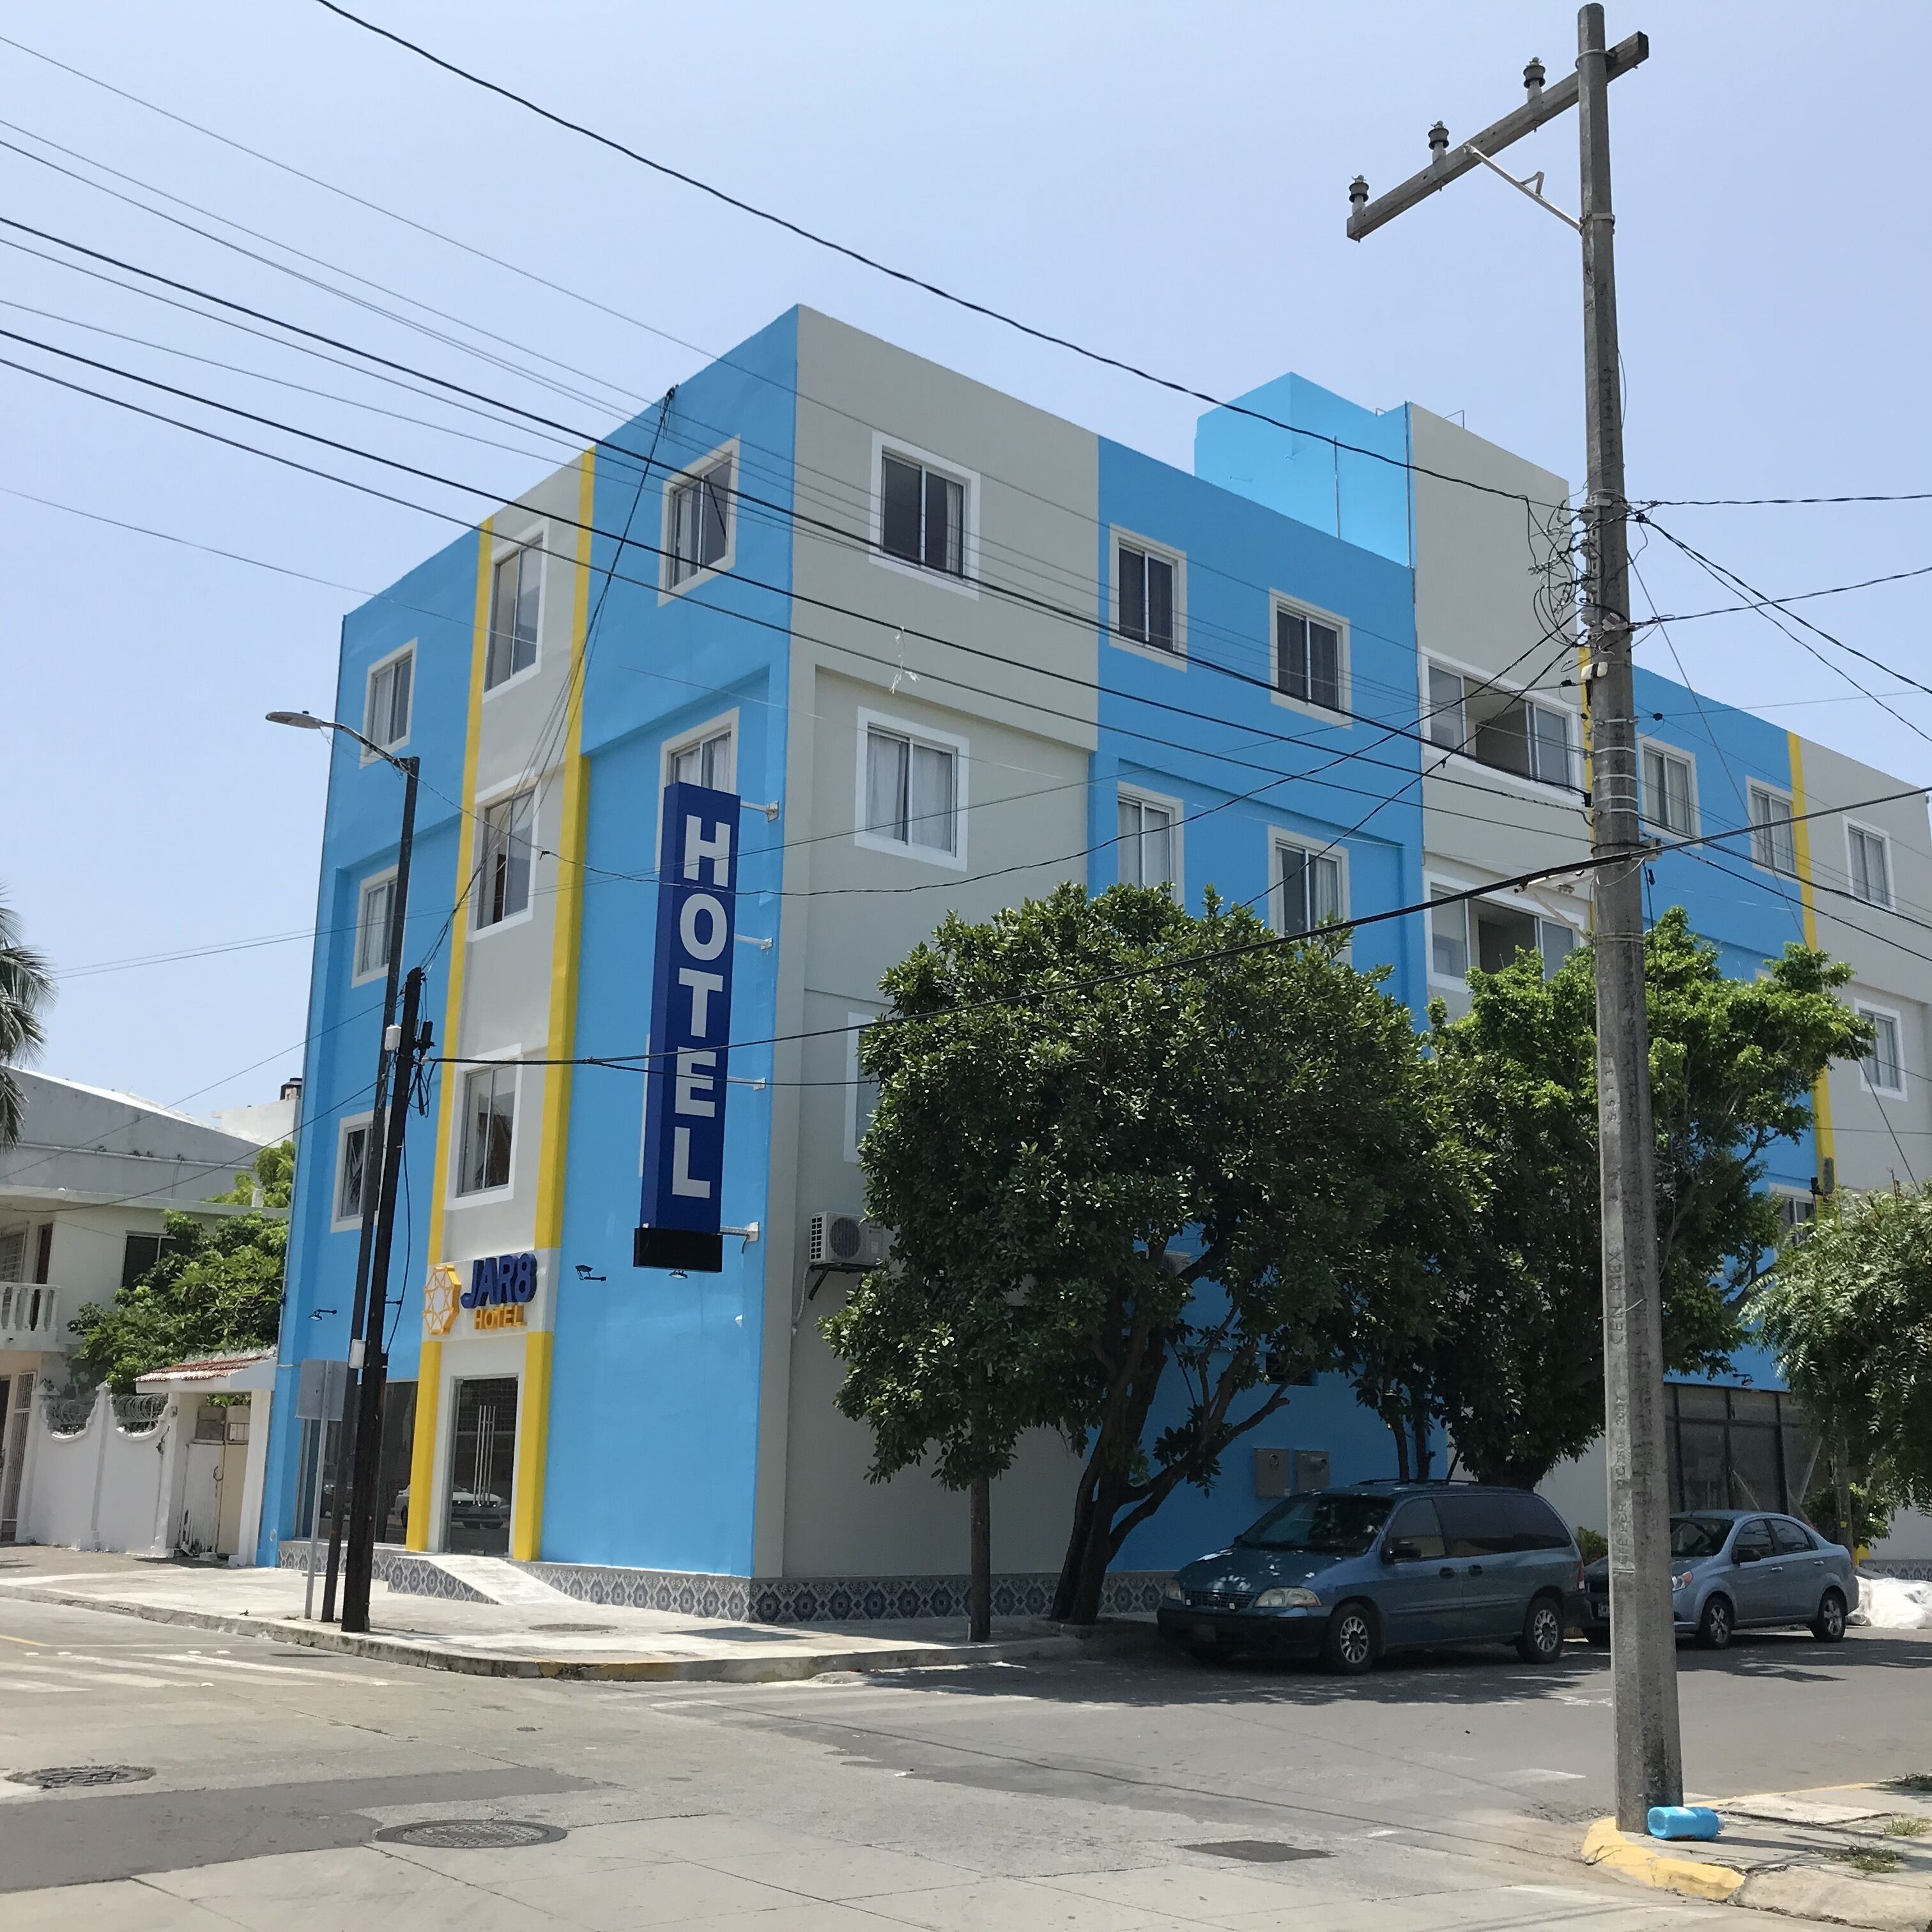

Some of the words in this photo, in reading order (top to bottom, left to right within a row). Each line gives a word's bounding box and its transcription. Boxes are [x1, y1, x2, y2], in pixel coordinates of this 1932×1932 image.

[671, 815, 732, 1199] HOTEL
[460, 1253, 537, 1309] JAR8
[474, 1305, 528, 1330] HOTEL
